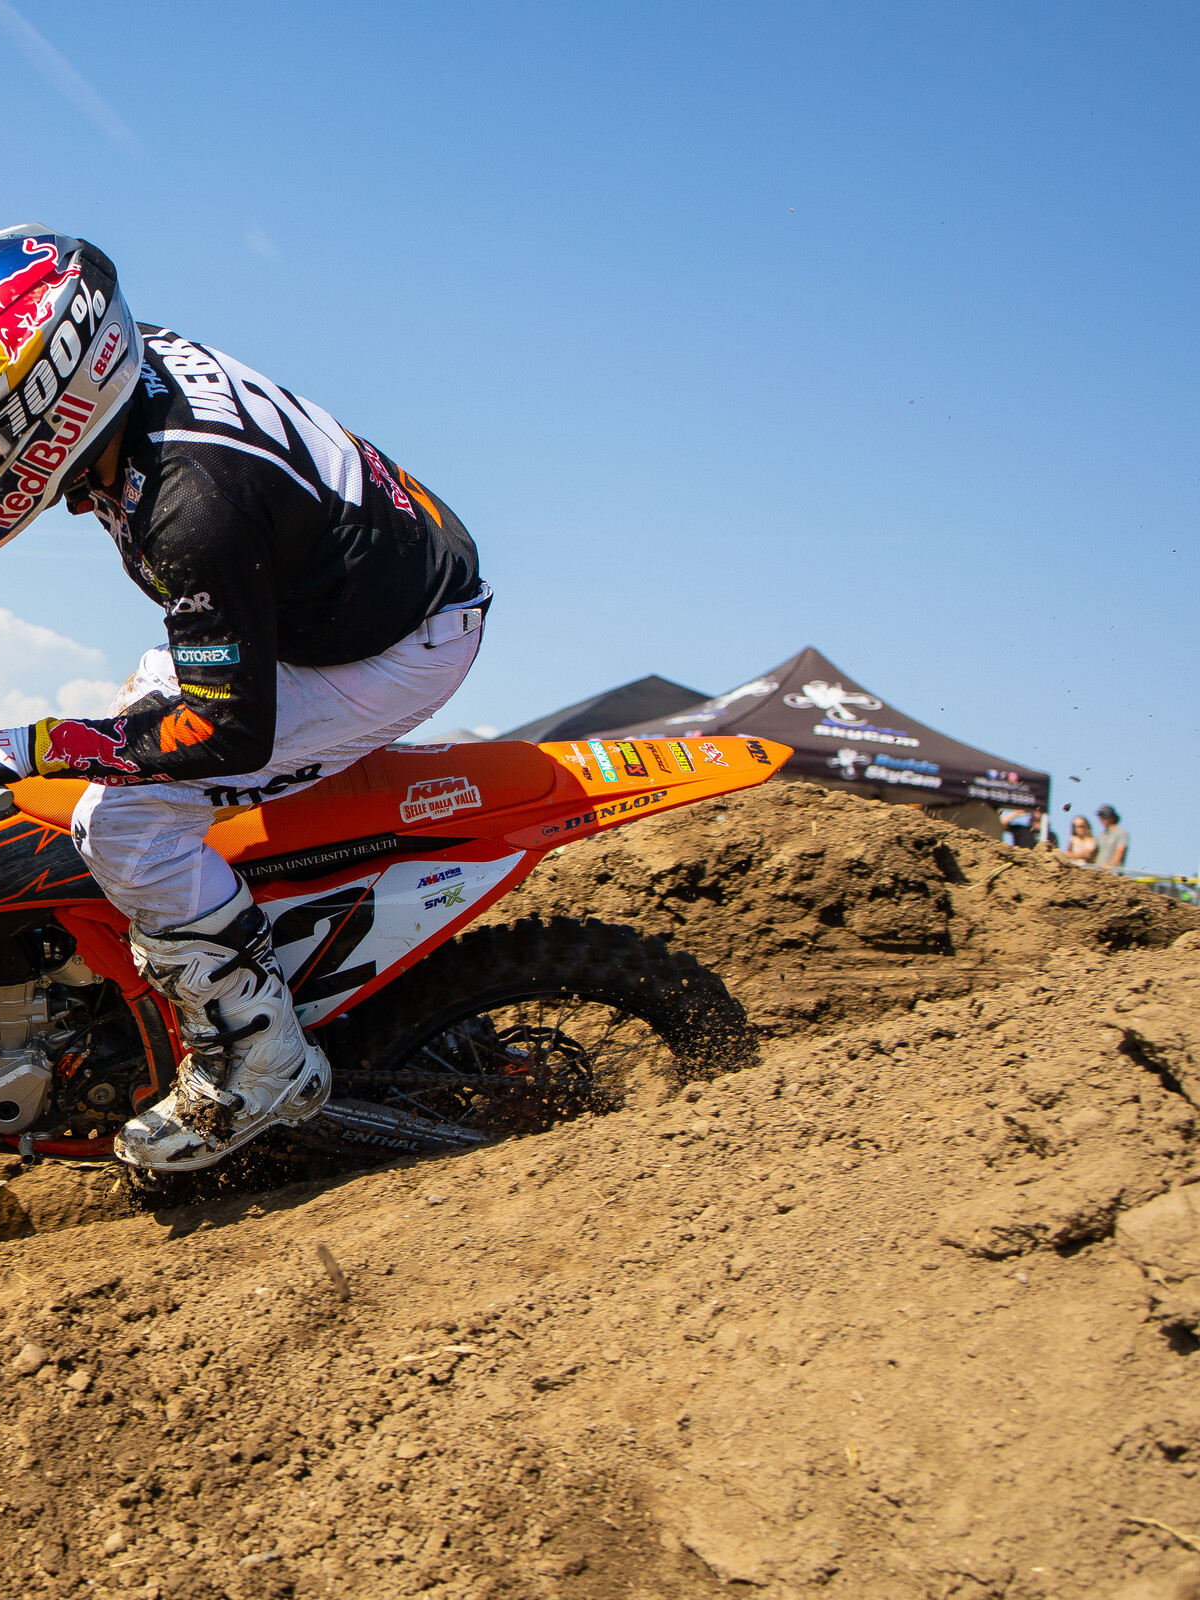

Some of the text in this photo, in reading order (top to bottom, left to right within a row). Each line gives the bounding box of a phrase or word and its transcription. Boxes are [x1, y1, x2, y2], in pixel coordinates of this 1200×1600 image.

[93, 330, 121, 379] BELL
[21, 392, 98, 473] Bull
[588, 741, 613, 772] MOTOREX
[668, 741, 693, 773] HINSON
[745, 739, 773, 766] KTM
[203, 762, 323, 807] THOR
[410, 778, 467, 803] KTM
[403, 788, 478, 820] SELLE DALLA VALLE
[434, 806, 450, 815] ITALY
[564, 789, 669, 831] DUNLOP
[249, 863, 285, 877] LINDA
[286, 848, 352, 870] UNIVERSITY
[352, 838, 398, 856] HEALTH
[416, 871, 446, 890] AMA
[424, 886, 467, 910] SMX
[334, 1131, 420, 1151] ENTHAL
